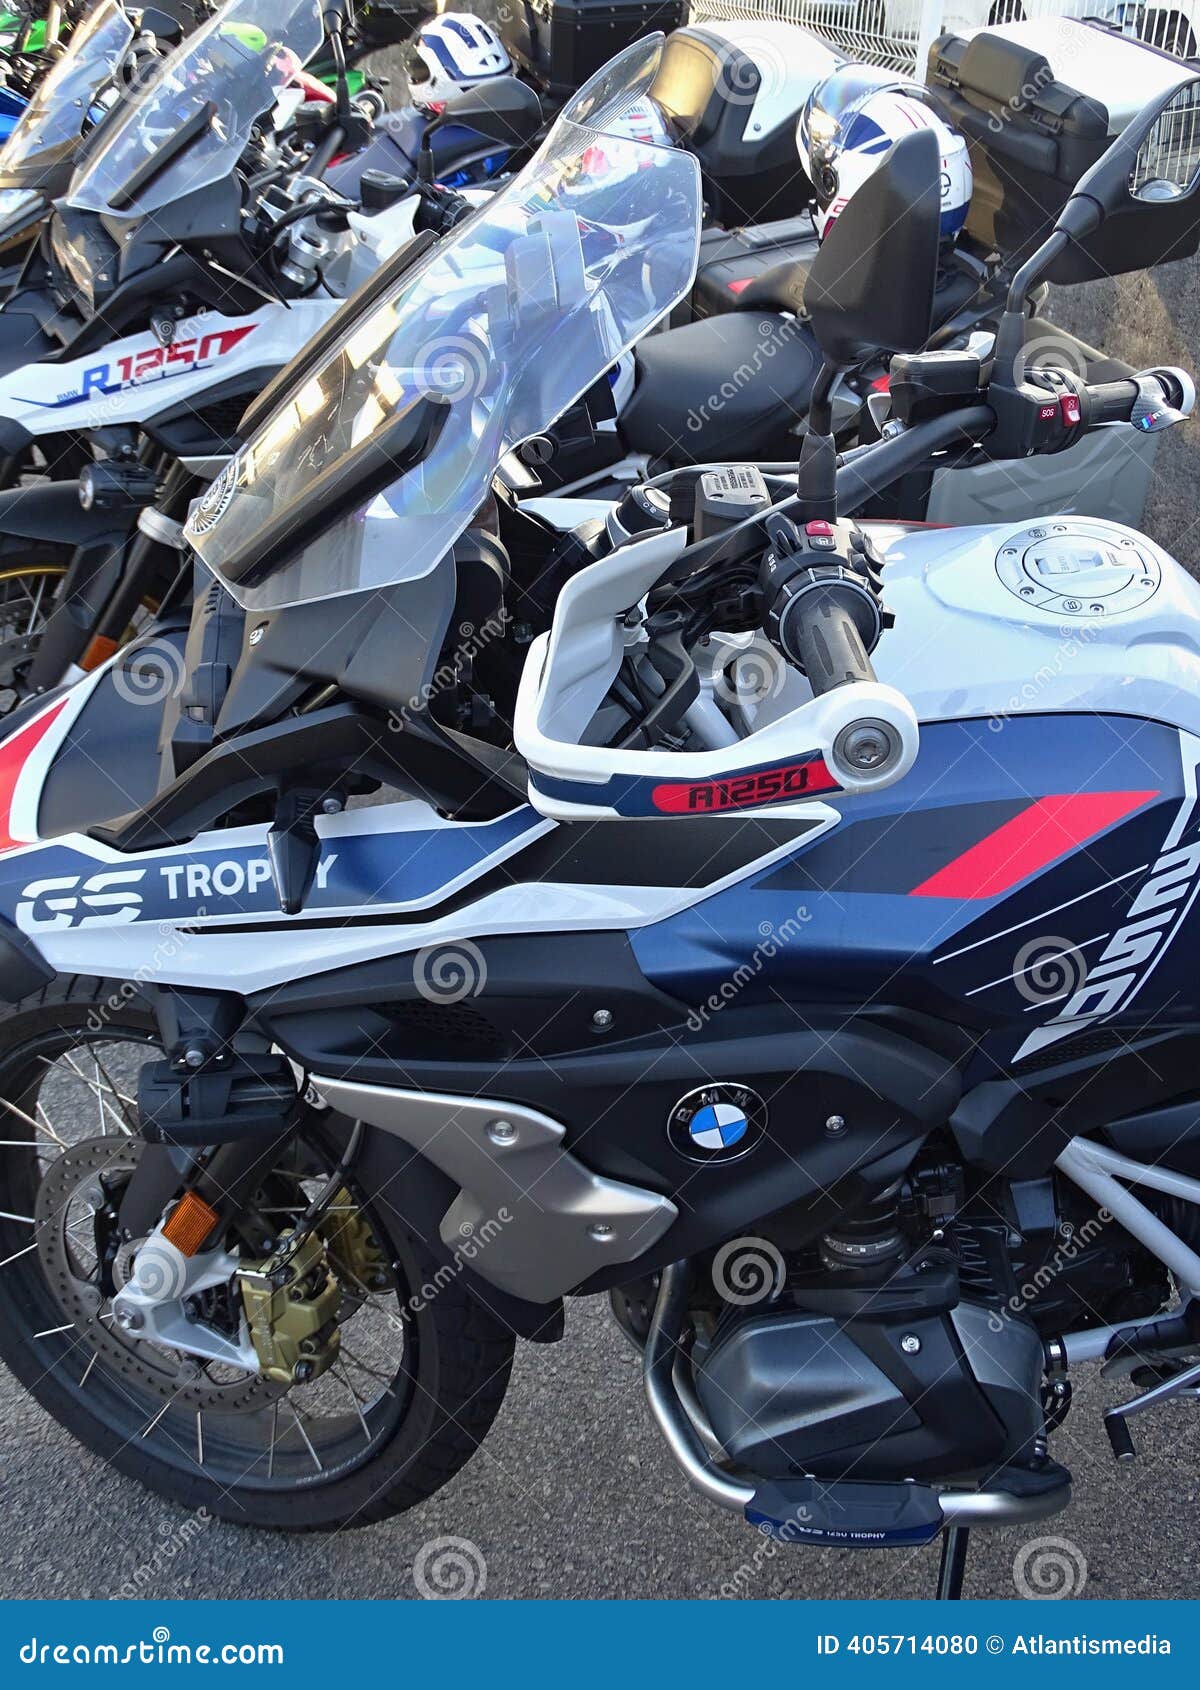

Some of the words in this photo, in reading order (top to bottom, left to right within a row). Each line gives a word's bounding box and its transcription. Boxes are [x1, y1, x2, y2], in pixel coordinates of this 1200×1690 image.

[1041, 408, 1055, 418] SOS
[688, 768, 808, 808] R1250
[15, 868, 147, 931] GS
[160, 854, 338, 899] TROPY
[675, 1088, 751, 1122] BMW
